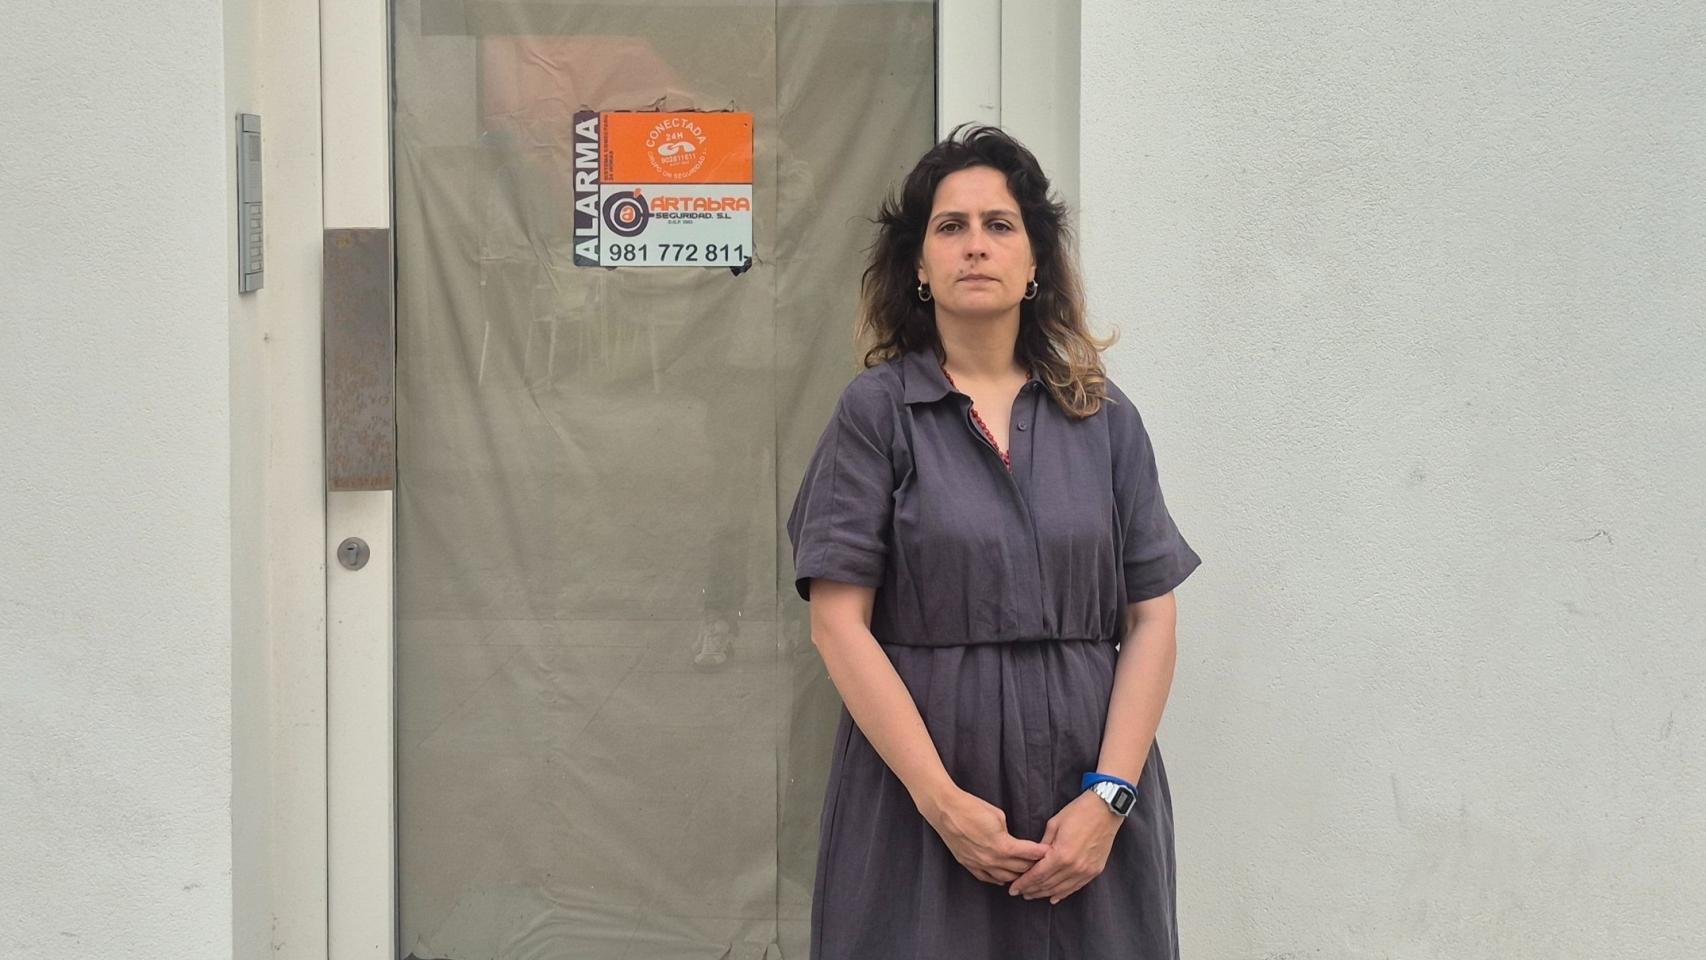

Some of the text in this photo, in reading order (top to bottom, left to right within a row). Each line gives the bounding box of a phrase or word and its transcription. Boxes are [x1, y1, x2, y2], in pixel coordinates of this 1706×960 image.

[646, 118, 706, 148] CONECTADA
[665, 132, 684, 142] 24H
[575, 117, 599, 262] ALARMA
[609, 243, 743, 262] 981 772 811
